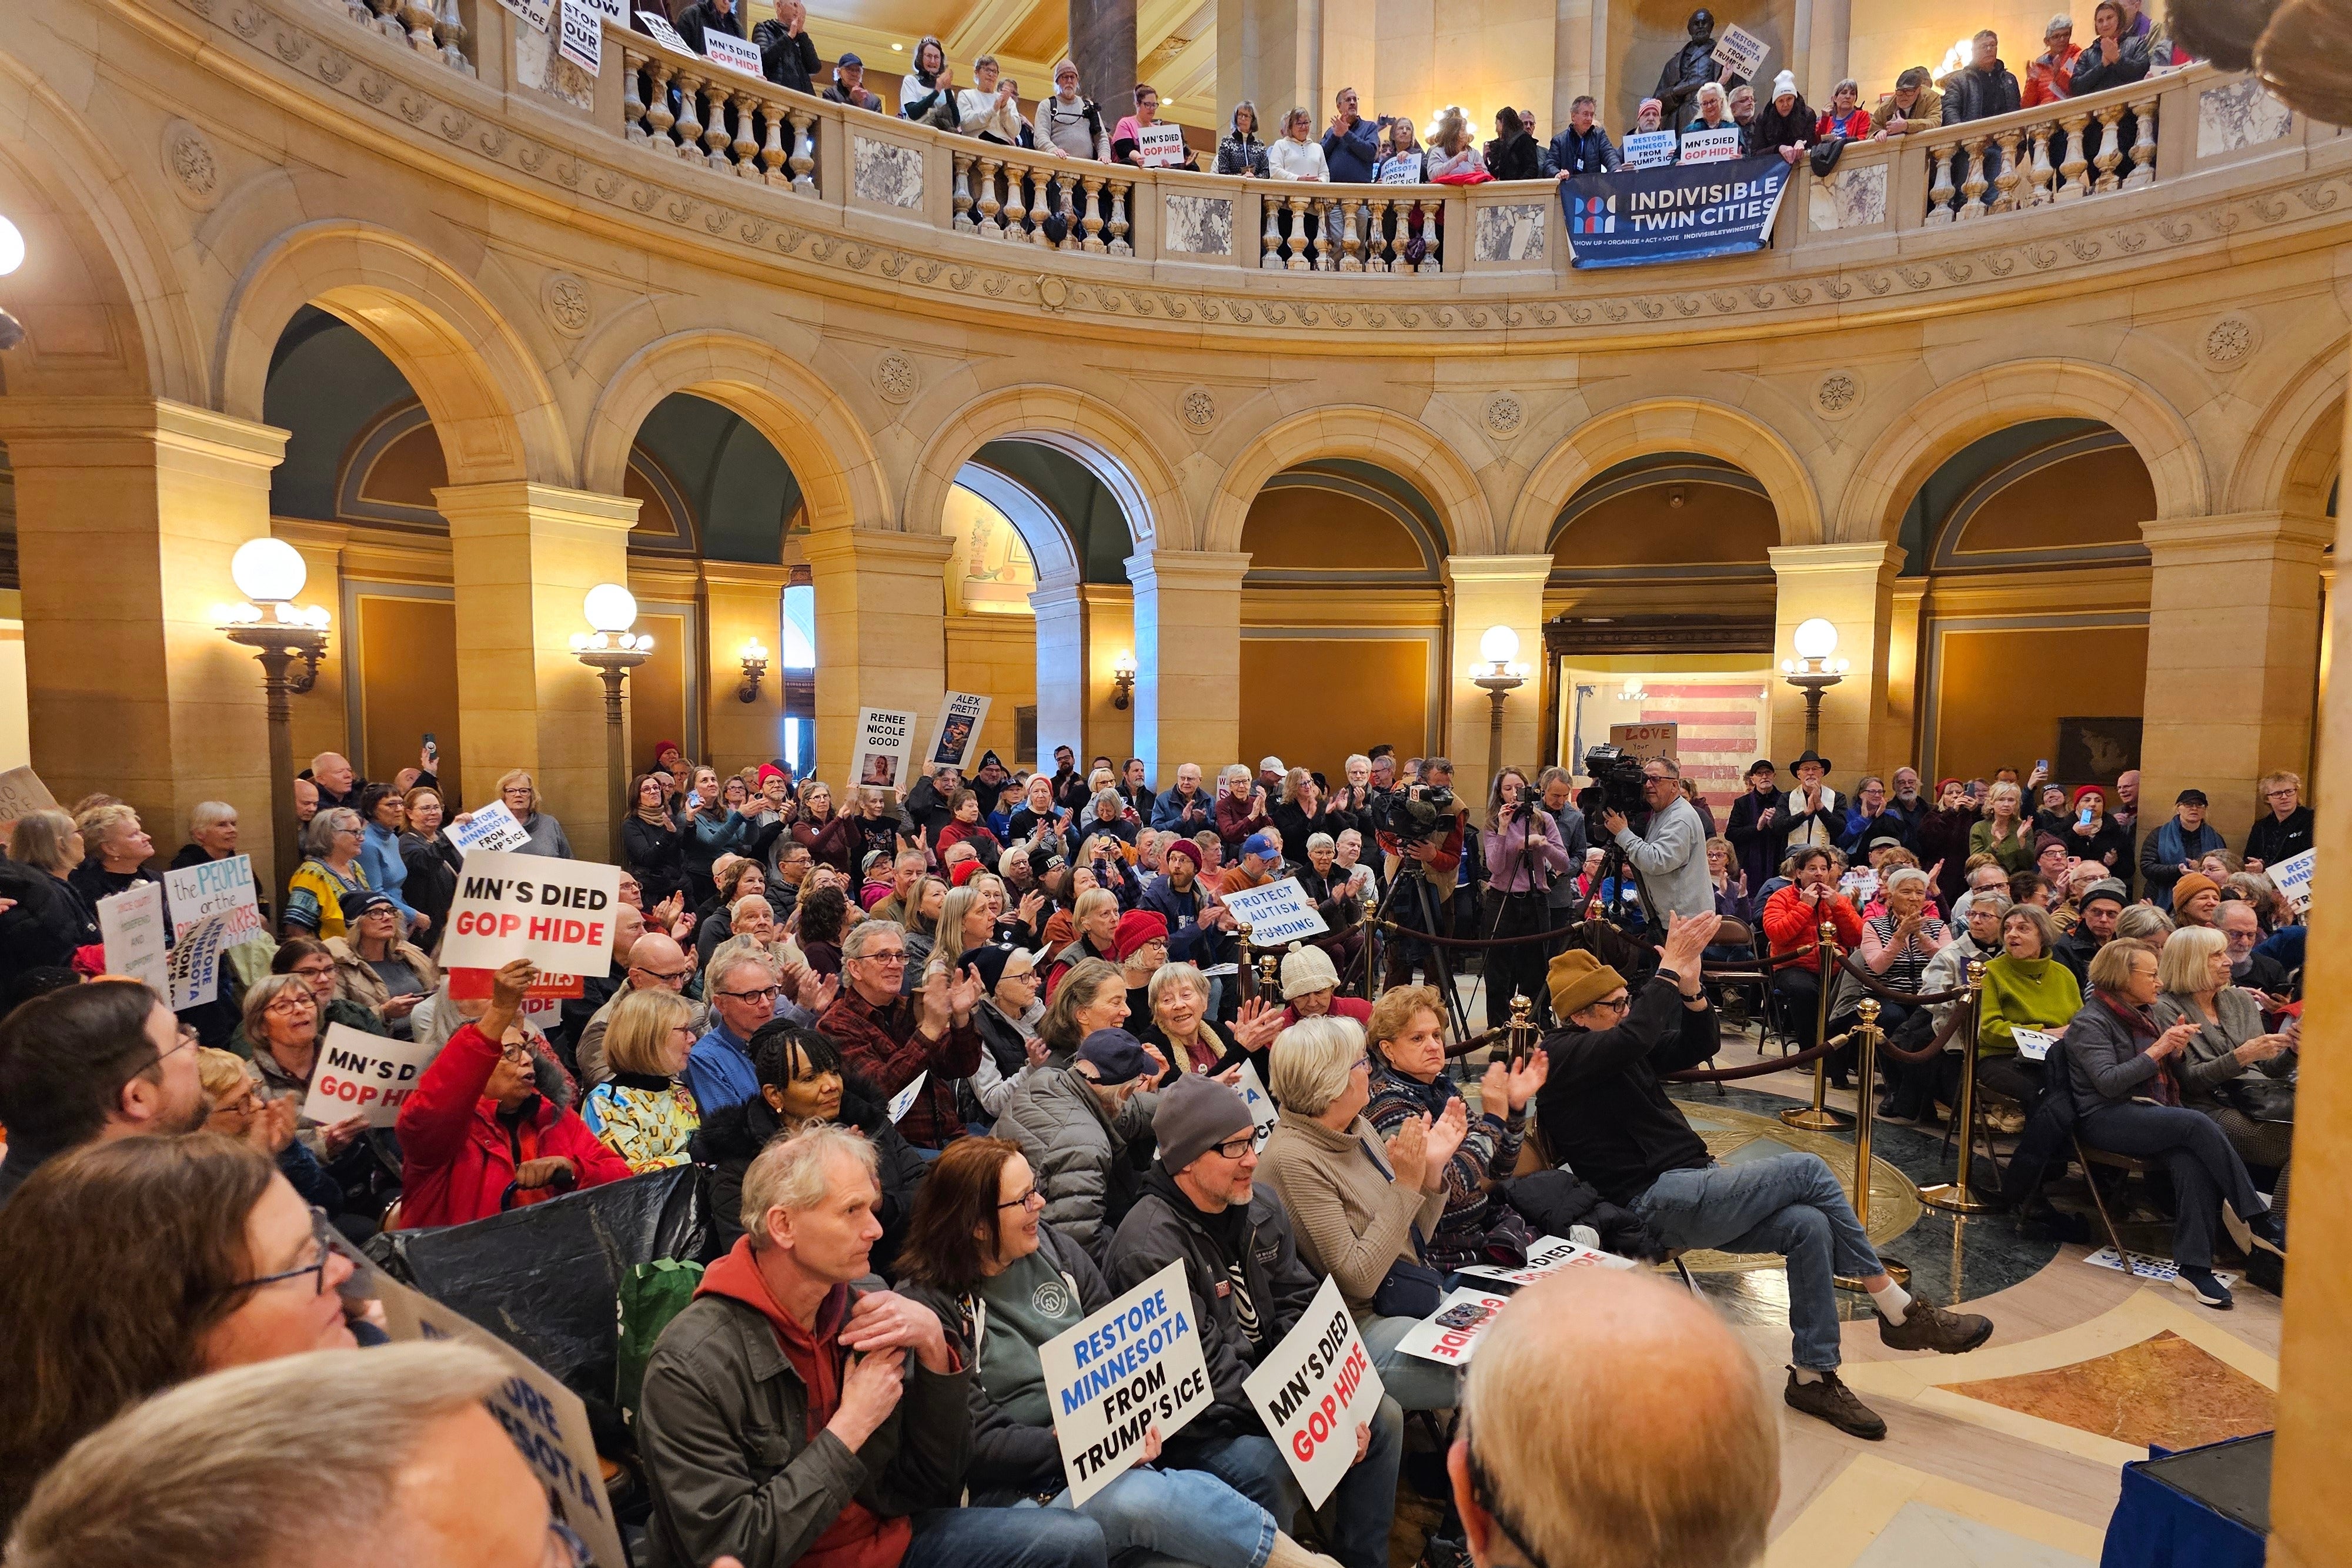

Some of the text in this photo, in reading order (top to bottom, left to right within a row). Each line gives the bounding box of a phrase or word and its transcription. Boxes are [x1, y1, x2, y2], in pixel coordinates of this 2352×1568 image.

[529, 10, 546, 26] ICE
[564, 2, 598, 28] STOP
[581, 0, 619, 16] OW
[565, 21, 597, 51] OUR
[642, 16, 678, 36] NO
[564, 33, 599, 58] NEIGHBORS
[709, 38, 758, 61] MN'S DIED
[1723, 35, 1760, 62] MINNESOTA
[1732, 31, 1760, 52] RESTORE
[710, 49, 760, 73] GOP HIDE
[1715, 49, 1753, 77] TRUMP'S ICE
[1727, 48, 1747, 62] FROM
[1142, 133, 1180, 145] MN'S DIED
[1144, 145, 1181, 156] GOP HIDE
[1627, 141, 1673, 152] MINNESOTA
[1633, 134, 1666, 145] RESTORE
[1685, 136, 1735, 149] MN'S DIED
[1639, 149, 1661, 158] FROM
[1685, 146, 1735, 160] GOP HIDE
[1631, 176, 1779, 211] INDIVISIBLE
[1631, 197, 1776, 232] TWIN CITIES
[950, 703, 980, 715] PRETTI
[956, 694, 981, 706] ALEX
[867, 724, 906, 736] NICOLE
[870, 713, 906, 725] RENEE
[868, 737, 899, 747] GOOD
[1625, 727, 1671, 741] LOVE
[457, 815, 512, 847] MINNESOTA
[459, 809, 499, 834] RESTORE
[478, 829, 507, 848] FROM
[511, 830, 526, 842] ICE
[174, 855, 252, 901] the PEOPLE
[201, 892, 236, 914] or the
[463, 876, 608, 911] MN'S DIED
[1231, 885, 1293, 910] PROTECT
[1250, 901, 1301, 922] AUTISM
[456, 911, 604, 946] GOP HIDE
[1255, 918, 1315, 941] FUNDING
[178, 935, 198, 980] FROM
[189, 917, 219, 1002] MINNESOTA
[202, 922, 225, 987] RESTORE
[522, 998, 554, 1015] IDE
[328, 1047, 395, 1079] MN'S
[320, 1075, 377, 1105] GOP
[1257, 1118, 1276, 1139] CE
[1529, 1245, 1576, 1266] DIED
[1073, 1288, 1168, 1370] RESTORE
[1060, 1311, 1190, 1416] MINNESOTA
[1268, 1310, 1349, 1429] MN'S DIED
[1102, 1360, 1167, 1426] FROM
[1292, 1340, 1368, 1462] GOP HIDE
[1072, 1367, 1205, 1483] TRUMP'S ICE
